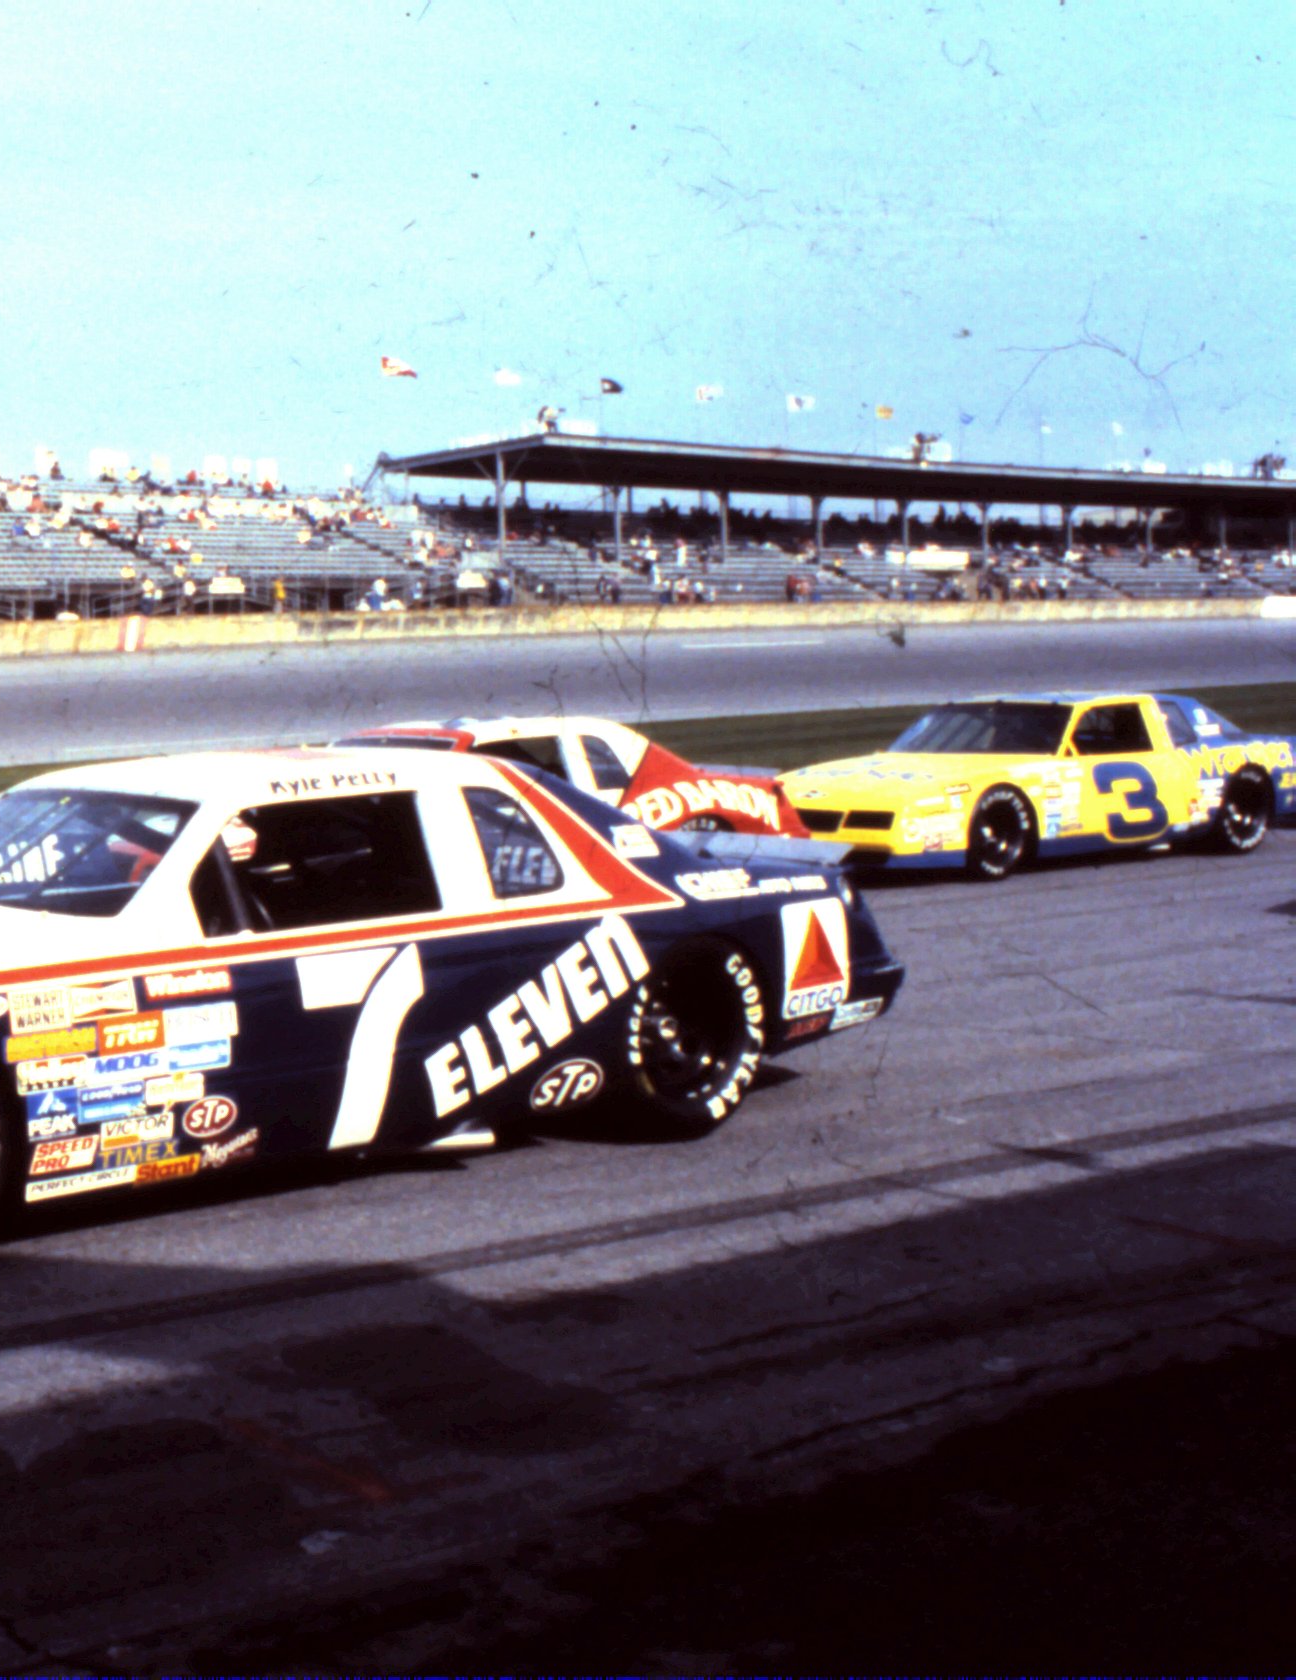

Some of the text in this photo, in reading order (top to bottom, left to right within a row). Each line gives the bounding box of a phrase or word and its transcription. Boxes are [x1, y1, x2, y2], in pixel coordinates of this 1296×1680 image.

[269, 778, 322, 796] Kyle
[1093, 762, 1168, 839] 3
[672, 779, 781, 831] BARON
[144, 970, 231, 998] Winston
[786, 986, 843, 1017] CITGO
[295, 942, 424, 1149] 7
[94, 1052, 159, 1074] MOOG
[534, 1064, 598, 1107] STP
[28, 1113, 77, 1138] PEAK
[105, 1114, 170, 1137] VICTOR
[189, 1100, 230, 1129] STP
[36, 1137, 94, 1158] SPEED
[99, 1141, 180, 1168] TIMEX
[32, 1155, 70, 1173] PRO
[136, 1158, 197, 1181] Stant
